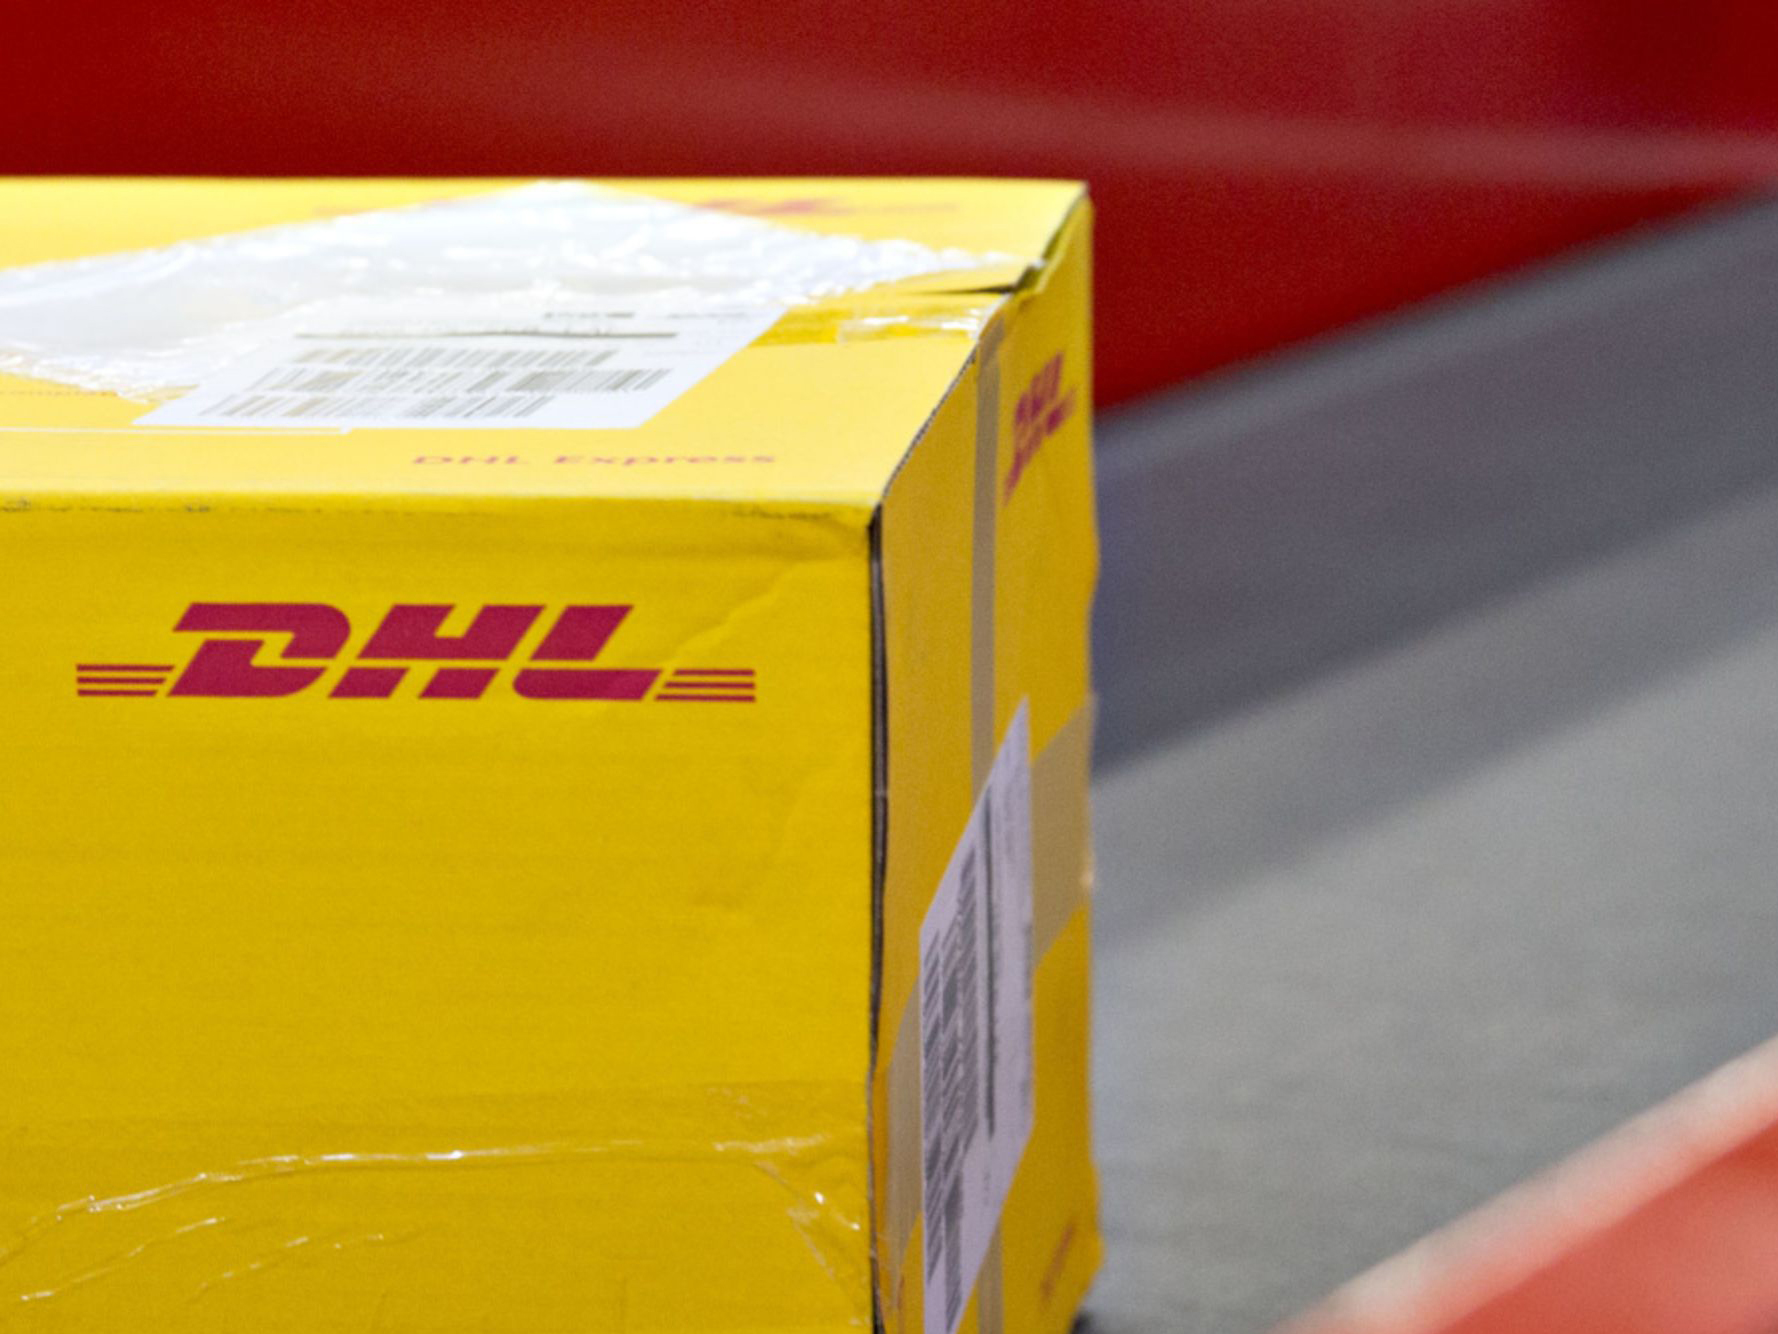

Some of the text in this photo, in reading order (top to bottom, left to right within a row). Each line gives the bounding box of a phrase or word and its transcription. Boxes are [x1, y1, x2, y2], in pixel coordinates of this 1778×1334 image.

[413, 454, 777, 468] DHL Express
[165, 602, 664, 702] DHL
